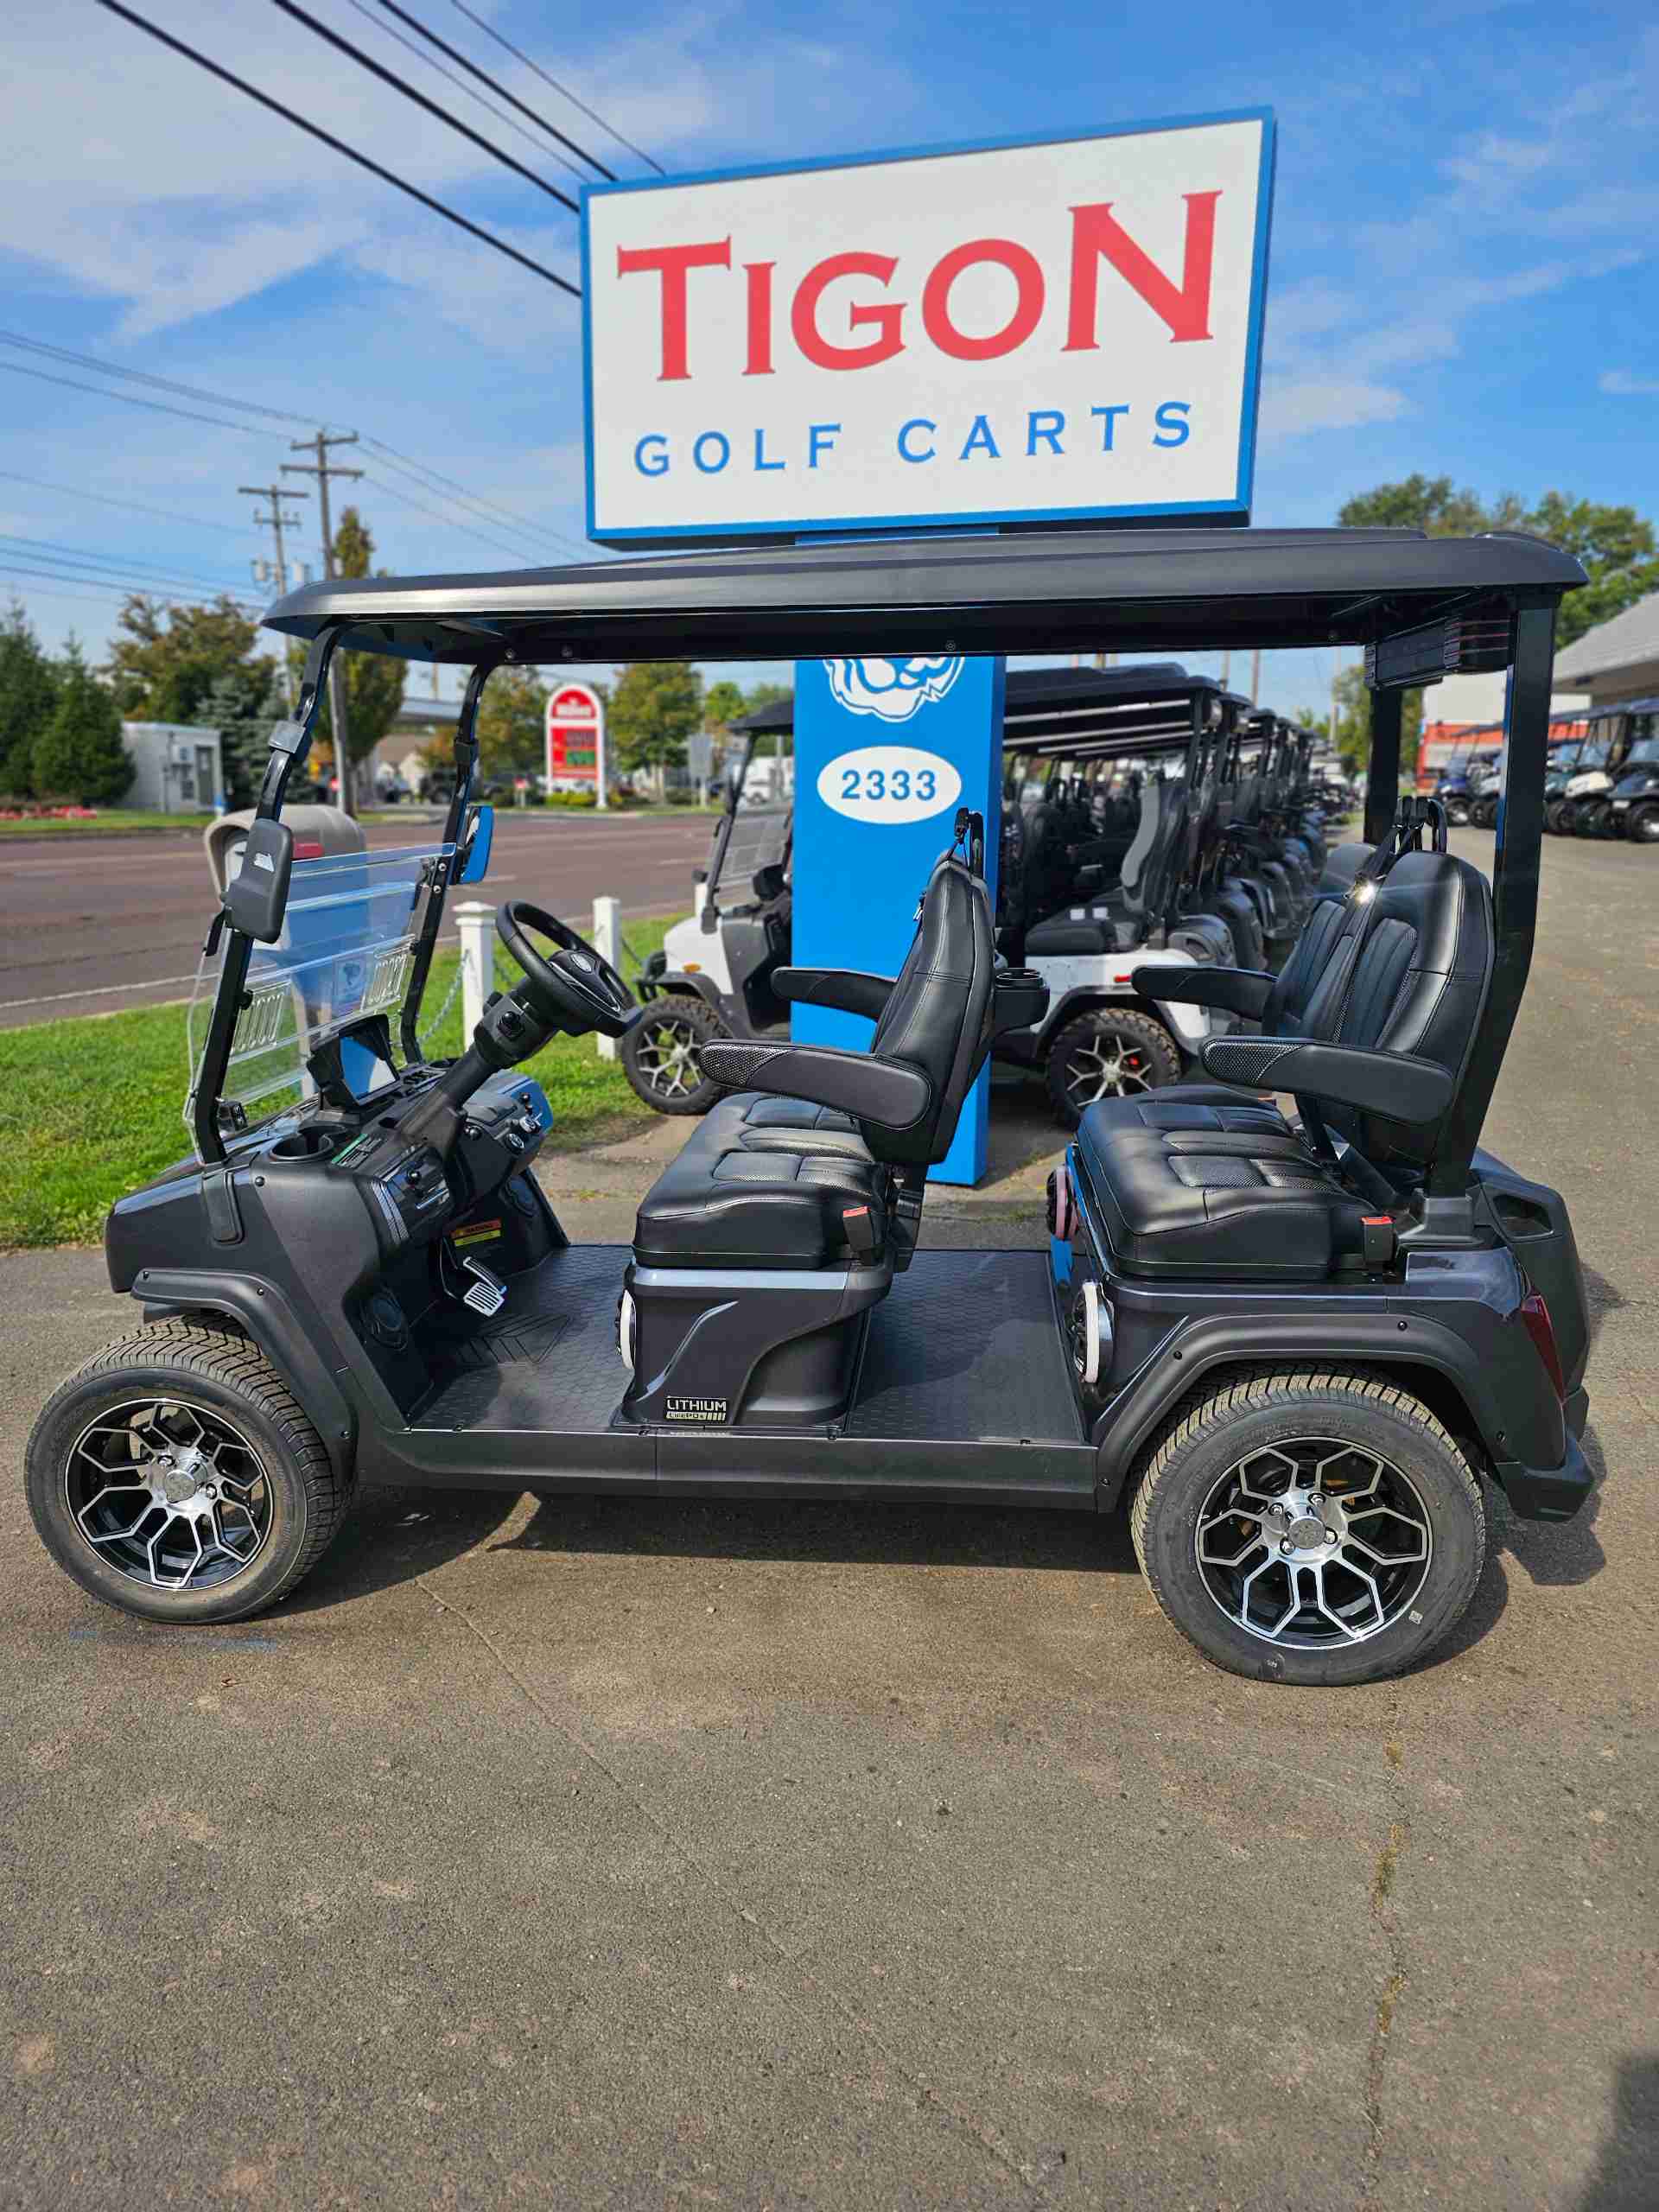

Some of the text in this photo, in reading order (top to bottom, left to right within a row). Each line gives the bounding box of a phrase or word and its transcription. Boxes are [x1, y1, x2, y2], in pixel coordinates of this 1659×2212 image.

[618, 191, 1220, 379] TIGON
[636, 401, 1190, 477] GOLF CARTS
[842, 770, 935, 801] 2333
[667, 1399, 727, 1411] LITHIUM
